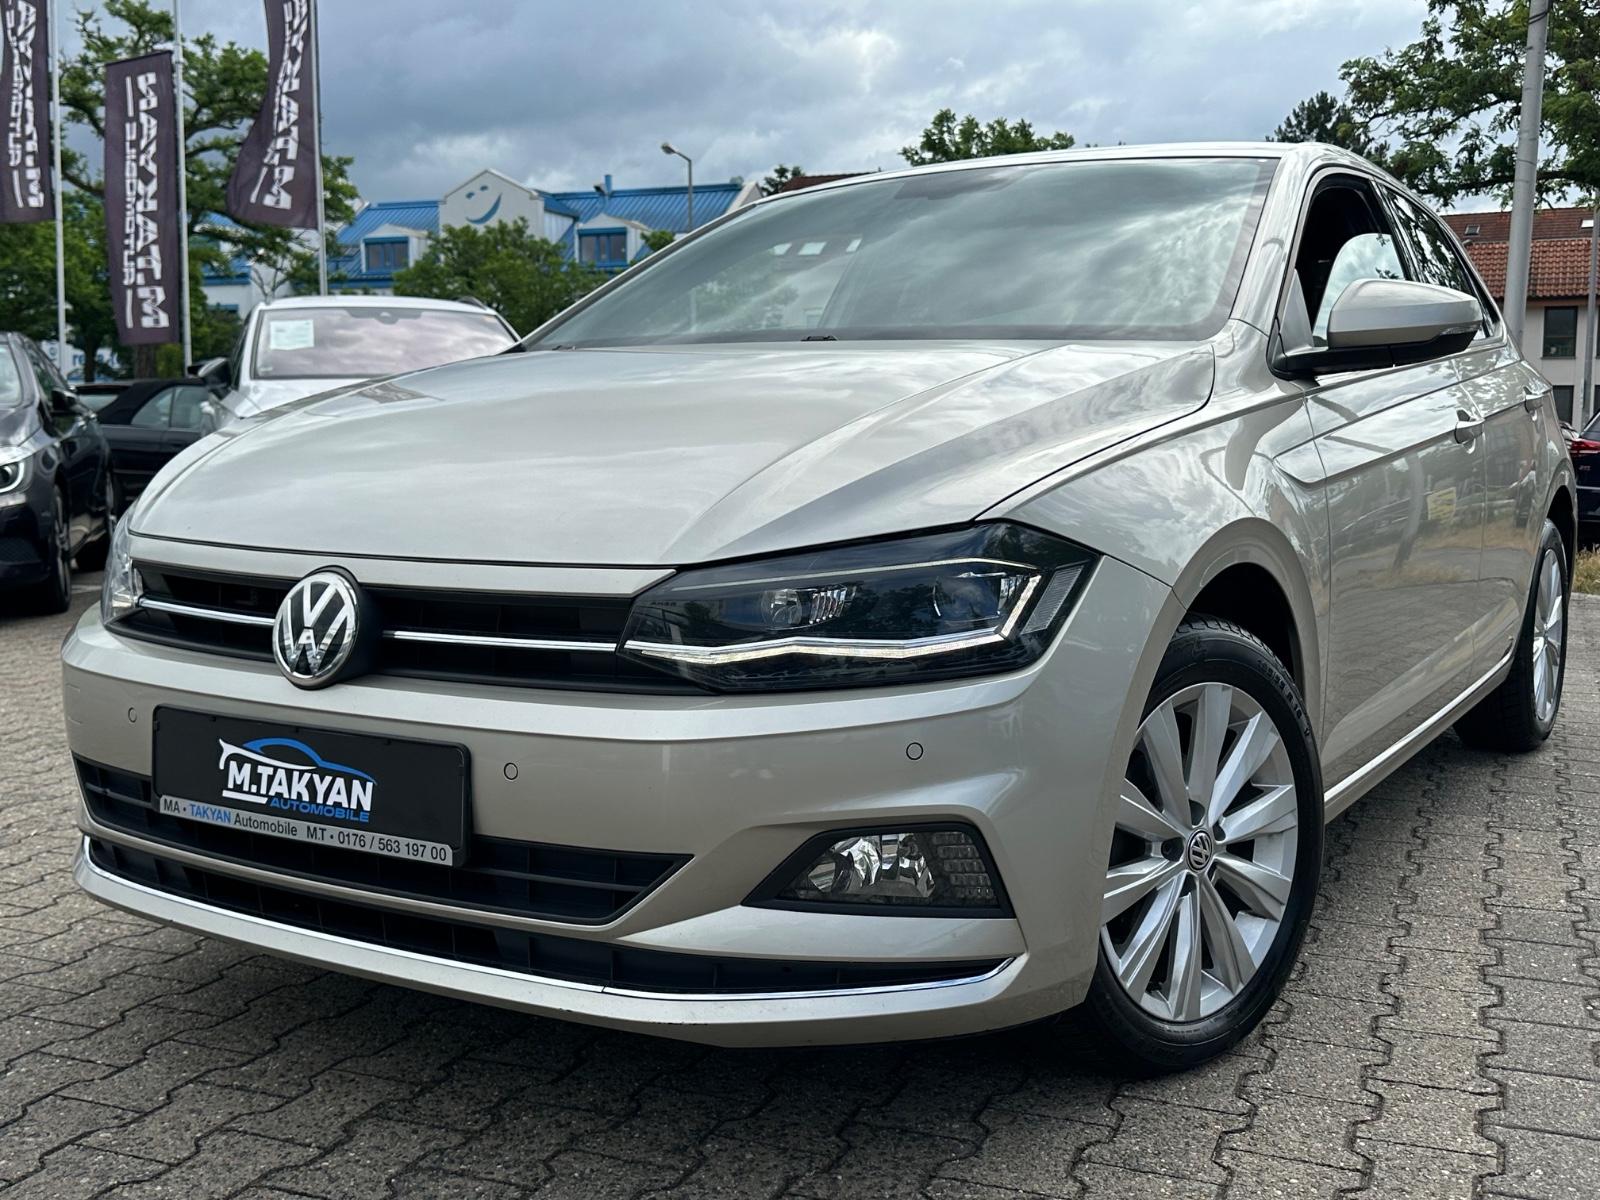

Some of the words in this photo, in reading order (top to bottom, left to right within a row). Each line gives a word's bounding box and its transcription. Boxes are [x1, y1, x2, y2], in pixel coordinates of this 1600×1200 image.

[227, 760, 374, 811] M.TAKYAN
[269, 797, 370, 822] AUTOMOBILE
[163, 799, 181, 813] MA
[190, 803, 232, 824] TAKYAN
[233, 812, 298, 837] Automobile
[337, 831, 367, 848] 0176
[378, 837, 401, 853] 563
[405, 842, 427, 858] 197
[430, 846, 447, 862] 00
